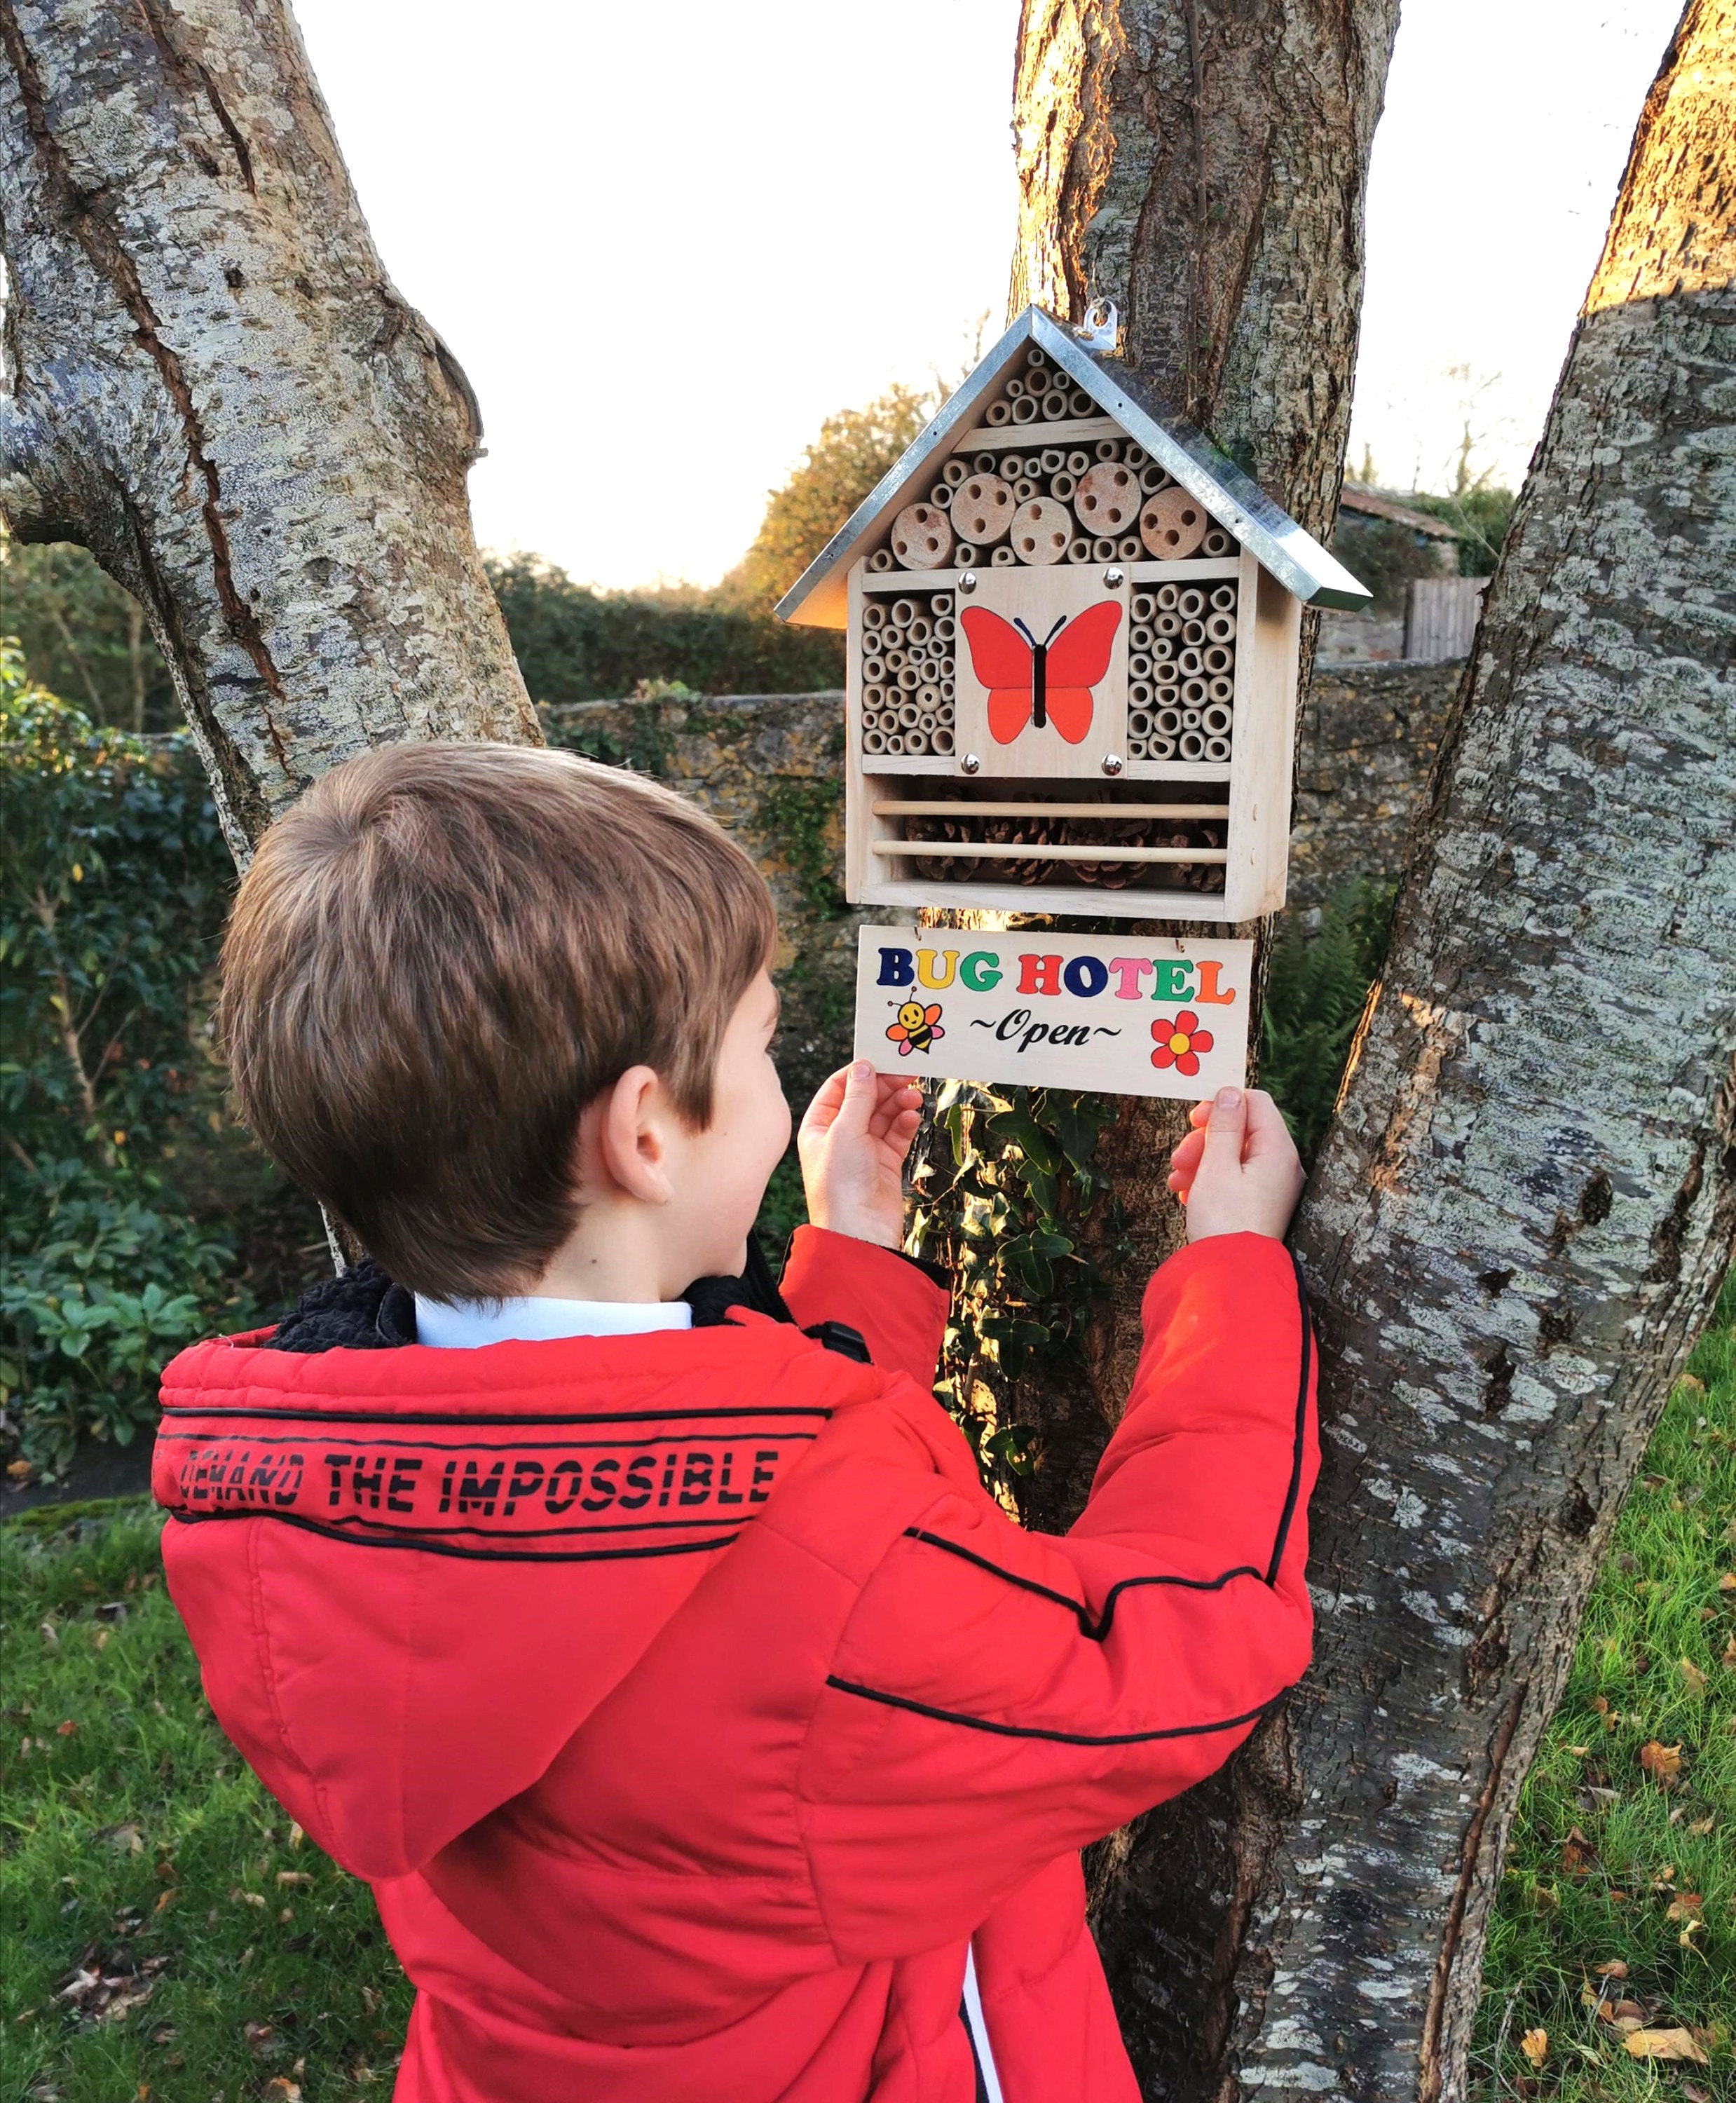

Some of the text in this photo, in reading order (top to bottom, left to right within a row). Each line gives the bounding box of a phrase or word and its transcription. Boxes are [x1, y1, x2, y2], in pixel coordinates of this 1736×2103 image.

[876, 947, 1236, 1005] BUG HOTEL
[324, 1454, 423, 1513] THE
[438, 1451, 779, 1516] IMPOSSIBLE
